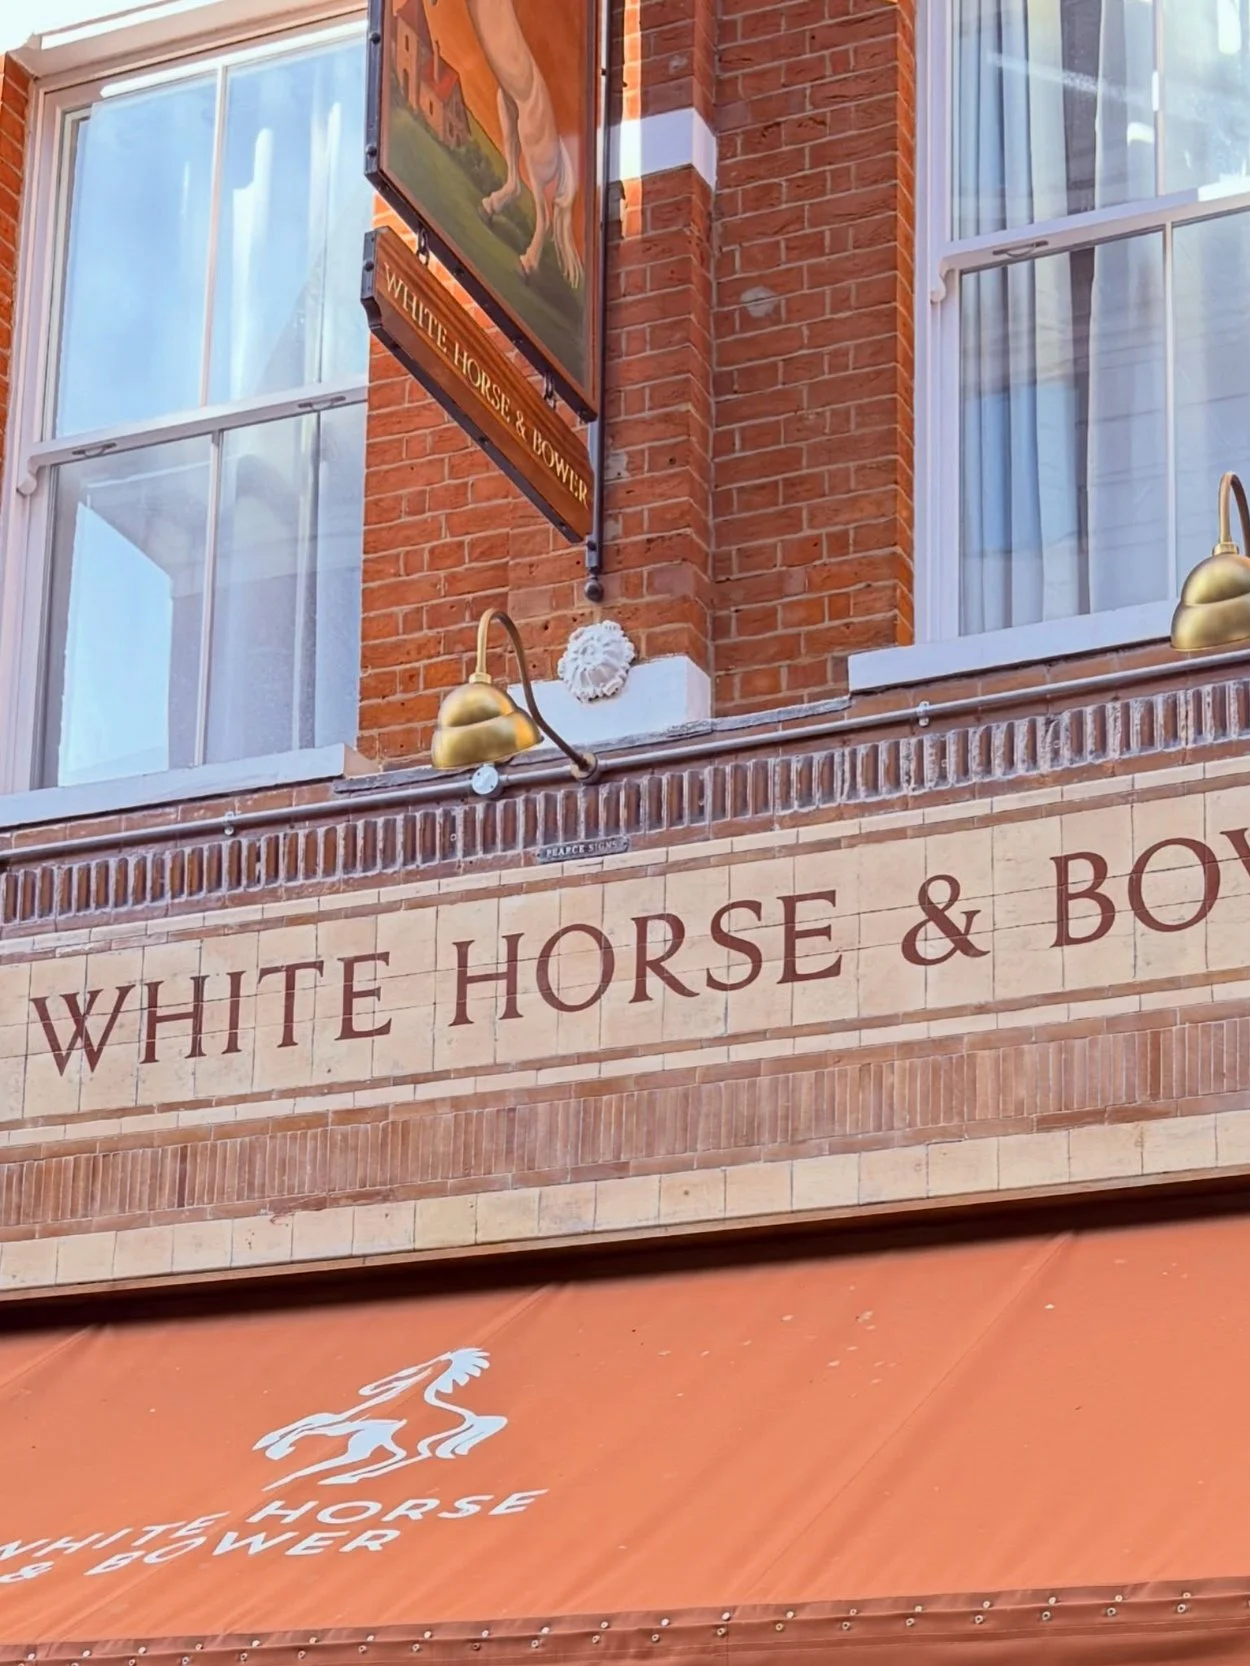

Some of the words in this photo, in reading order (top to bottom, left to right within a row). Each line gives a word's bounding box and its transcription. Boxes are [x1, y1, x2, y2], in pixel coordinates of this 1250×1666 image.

[384, 262, 448, 352] WHITE
[453, 342, 511, 423] HORSE
[514, 409, 528, 441] &
[532, 427, 588, 507] BOWER
[546, 844, 585, 857] PEARCE
[30, 951, 392, 1077] WHITE
[448, 889, 843, 1027] HORSE
[900, 873, 990, 967] &
[246, 1489, 549, 1525] HORSE
[83, 1528, 401, 1576] BOWER
